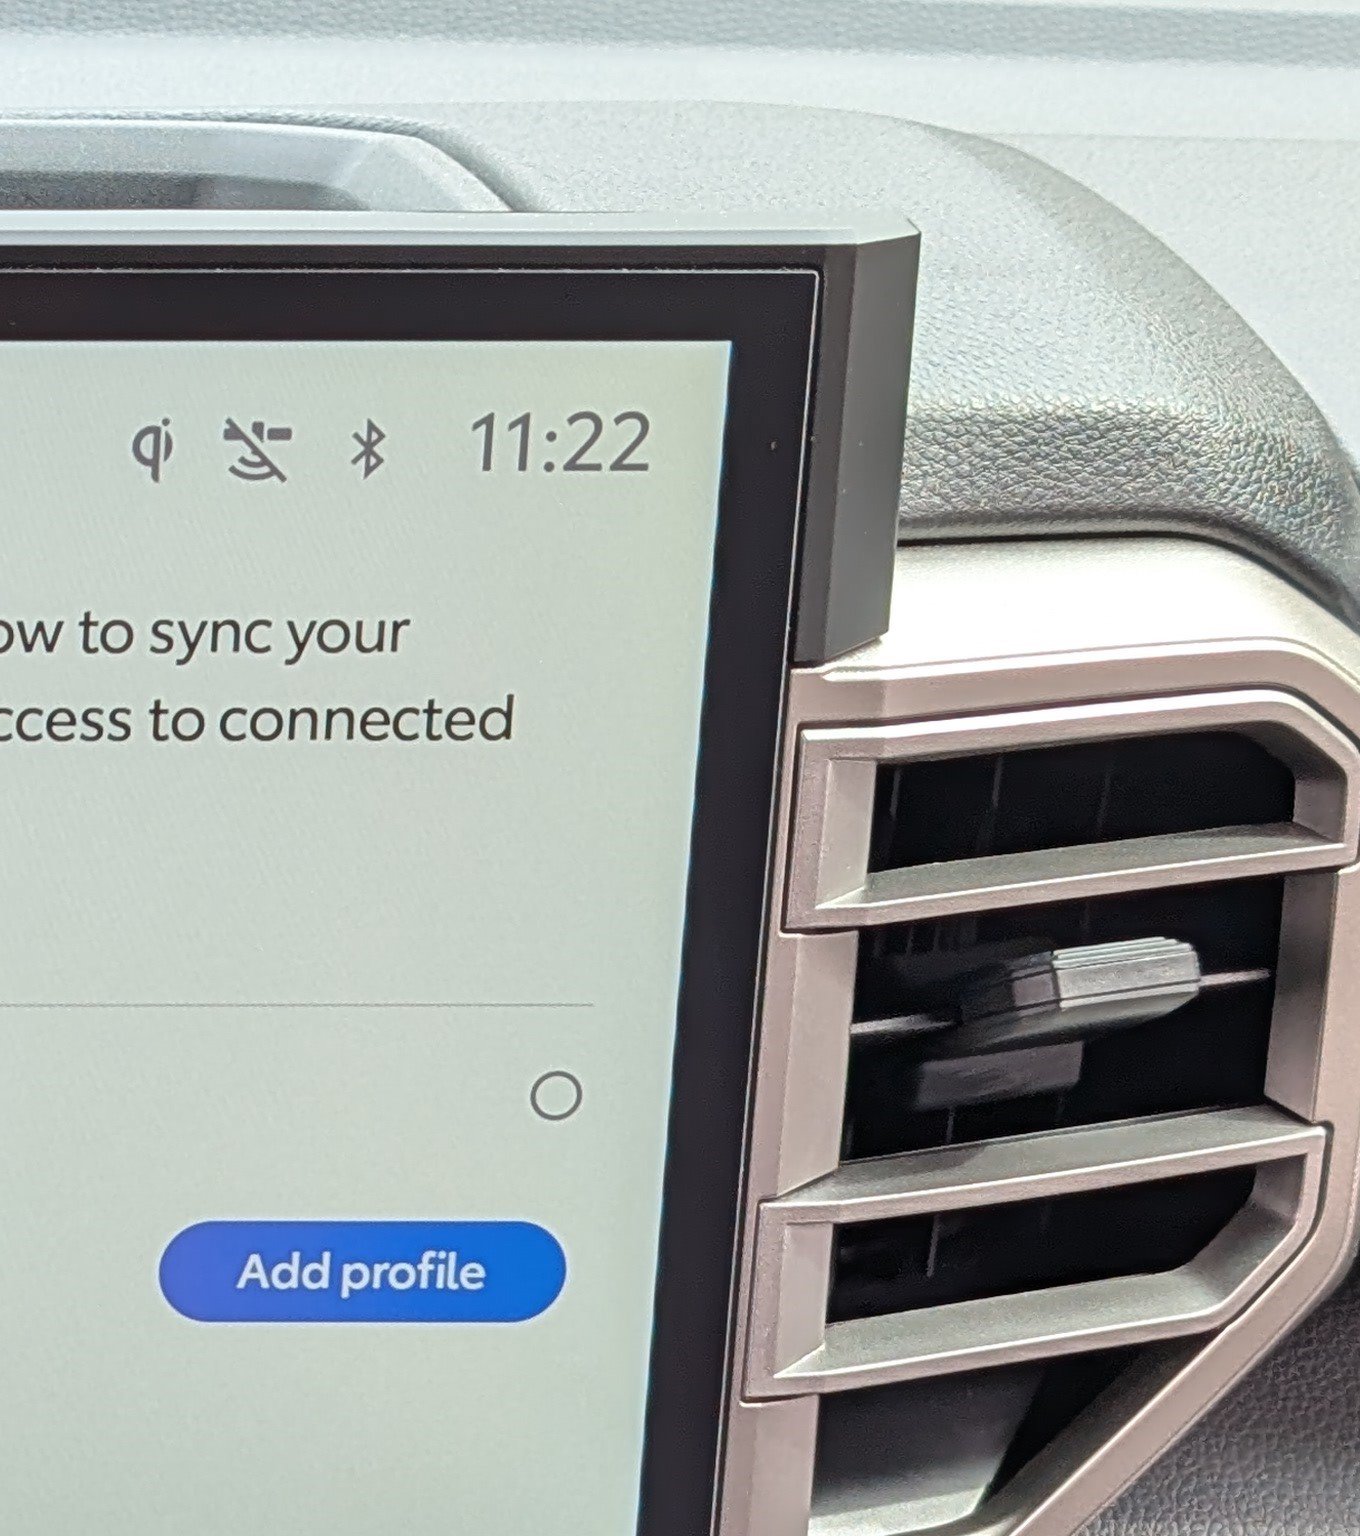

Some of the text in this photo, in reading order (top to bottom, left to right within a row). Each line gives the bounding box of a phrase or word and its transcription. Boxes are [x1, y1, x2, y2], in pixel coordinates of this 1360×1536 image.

[472, 411, 649, 472] 11:22
[79, 611, 133, 654] to
[150, 620, 272, 665] sync
[285, 619, 410, 665] your
[149, 699, 205, 741] to
[220, 694, 514, 741] connected
[237, 1251, 486, 1298] Add profile
